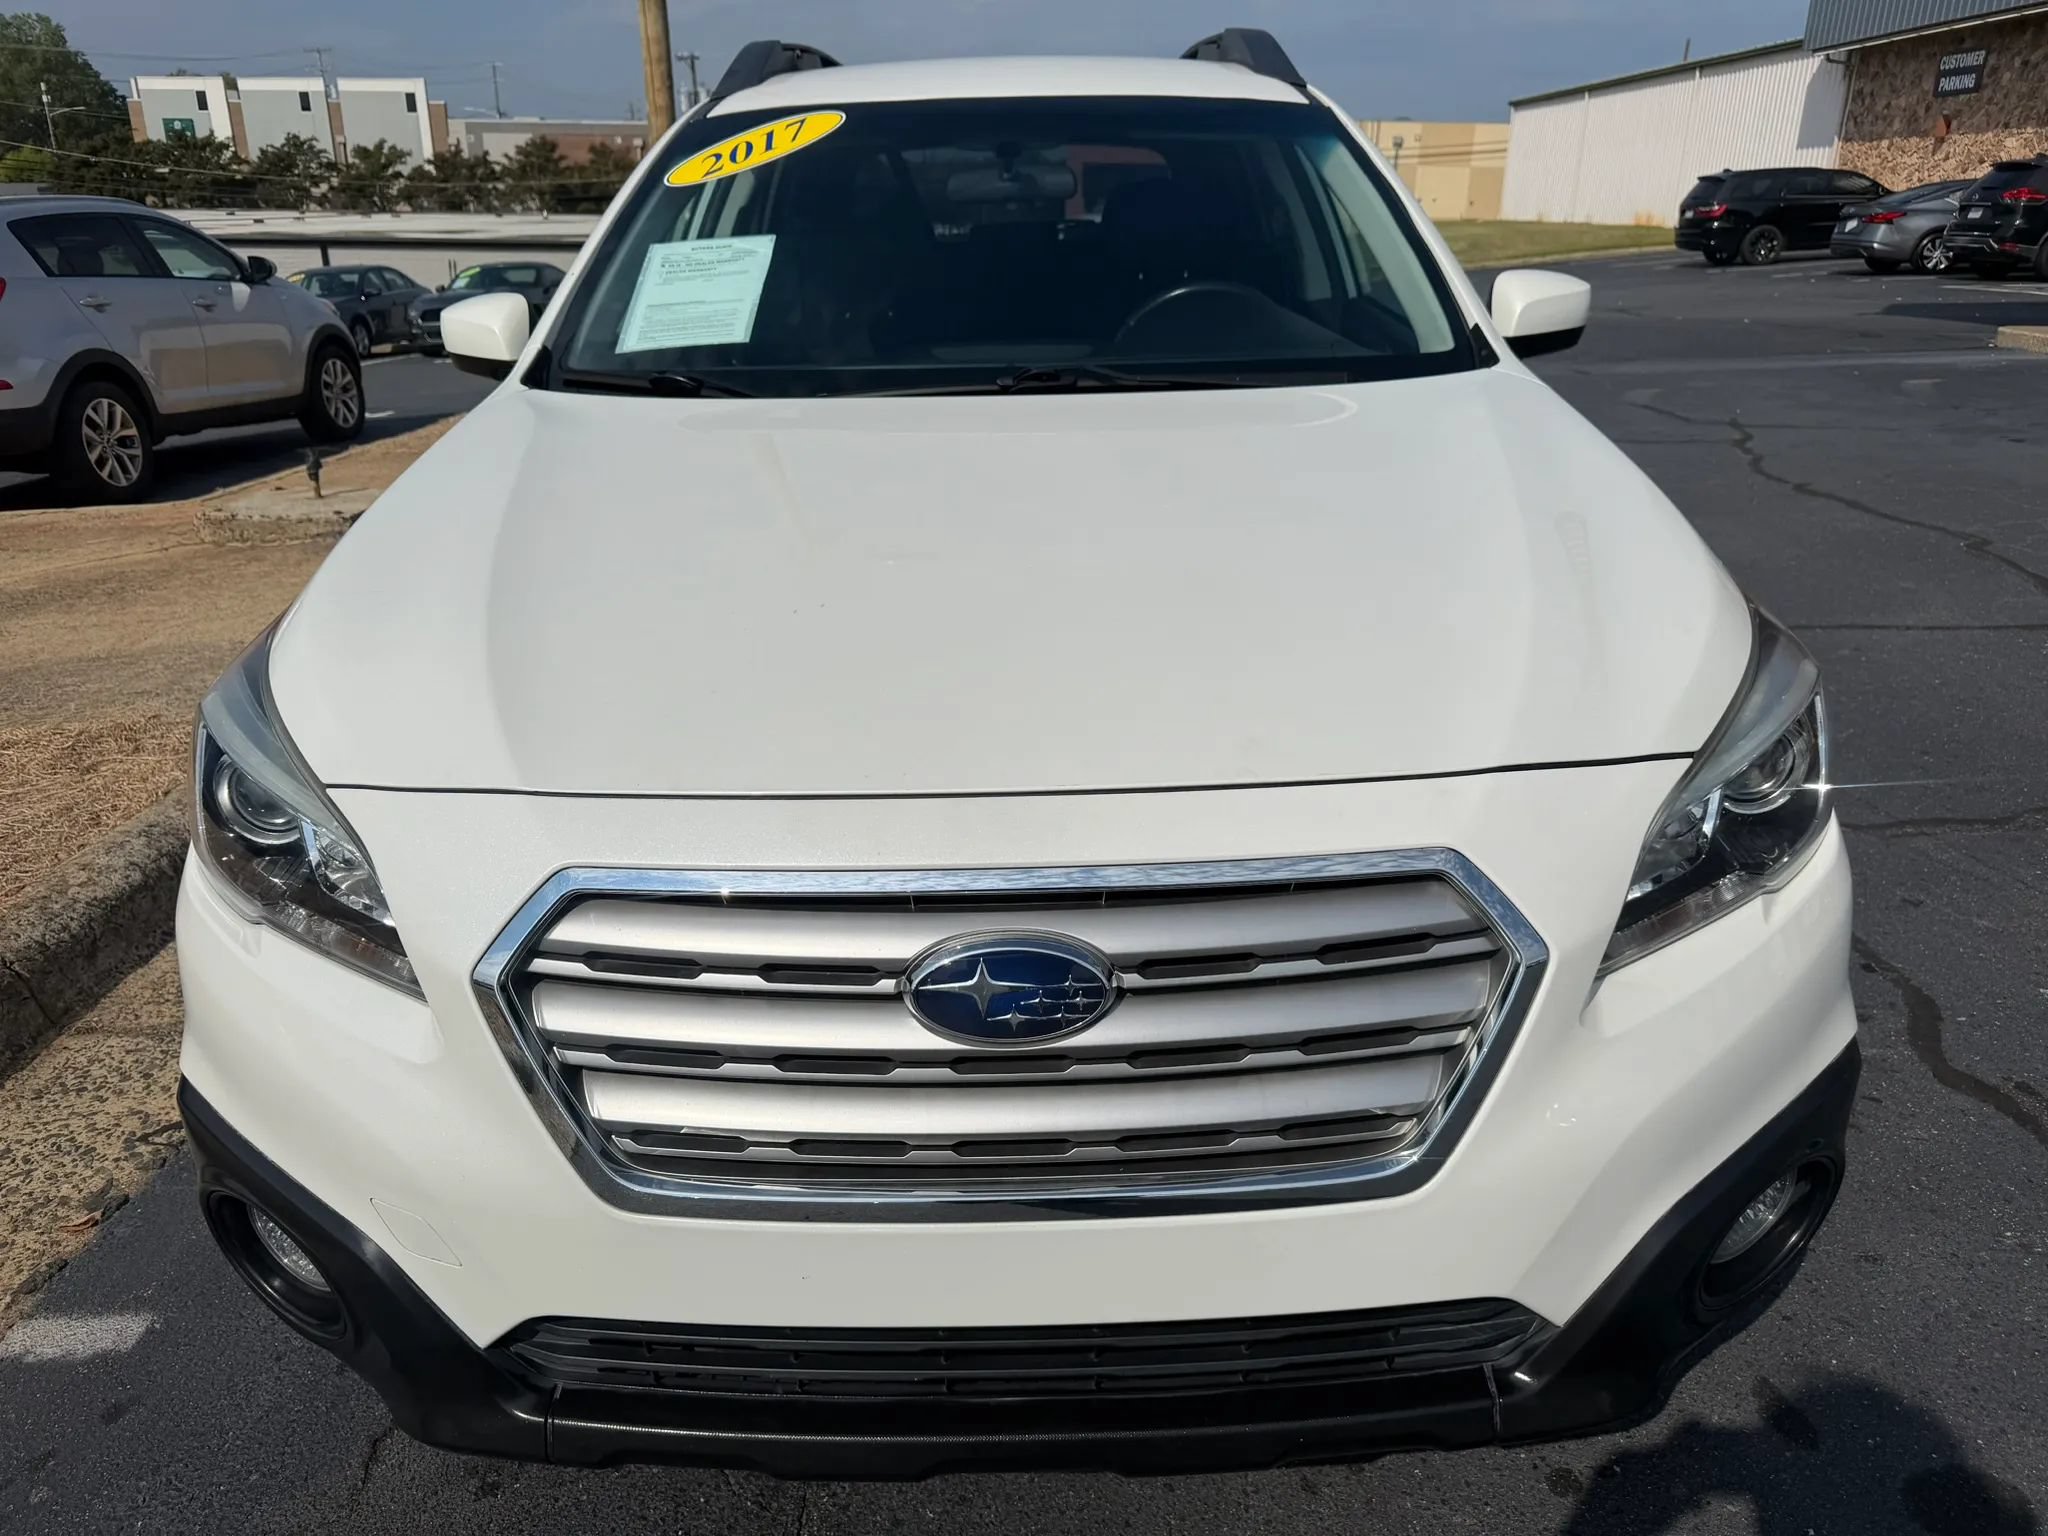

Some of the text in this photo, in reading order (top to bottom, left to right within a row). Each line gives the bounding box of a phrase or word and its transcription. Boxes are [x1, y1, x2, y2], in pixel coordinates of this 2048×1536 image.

[1941, 51, 1986, 70] CUSTOMER
[1937, 73, 1976, 92] PARKING
[701, 117, 808, 178] 2017
